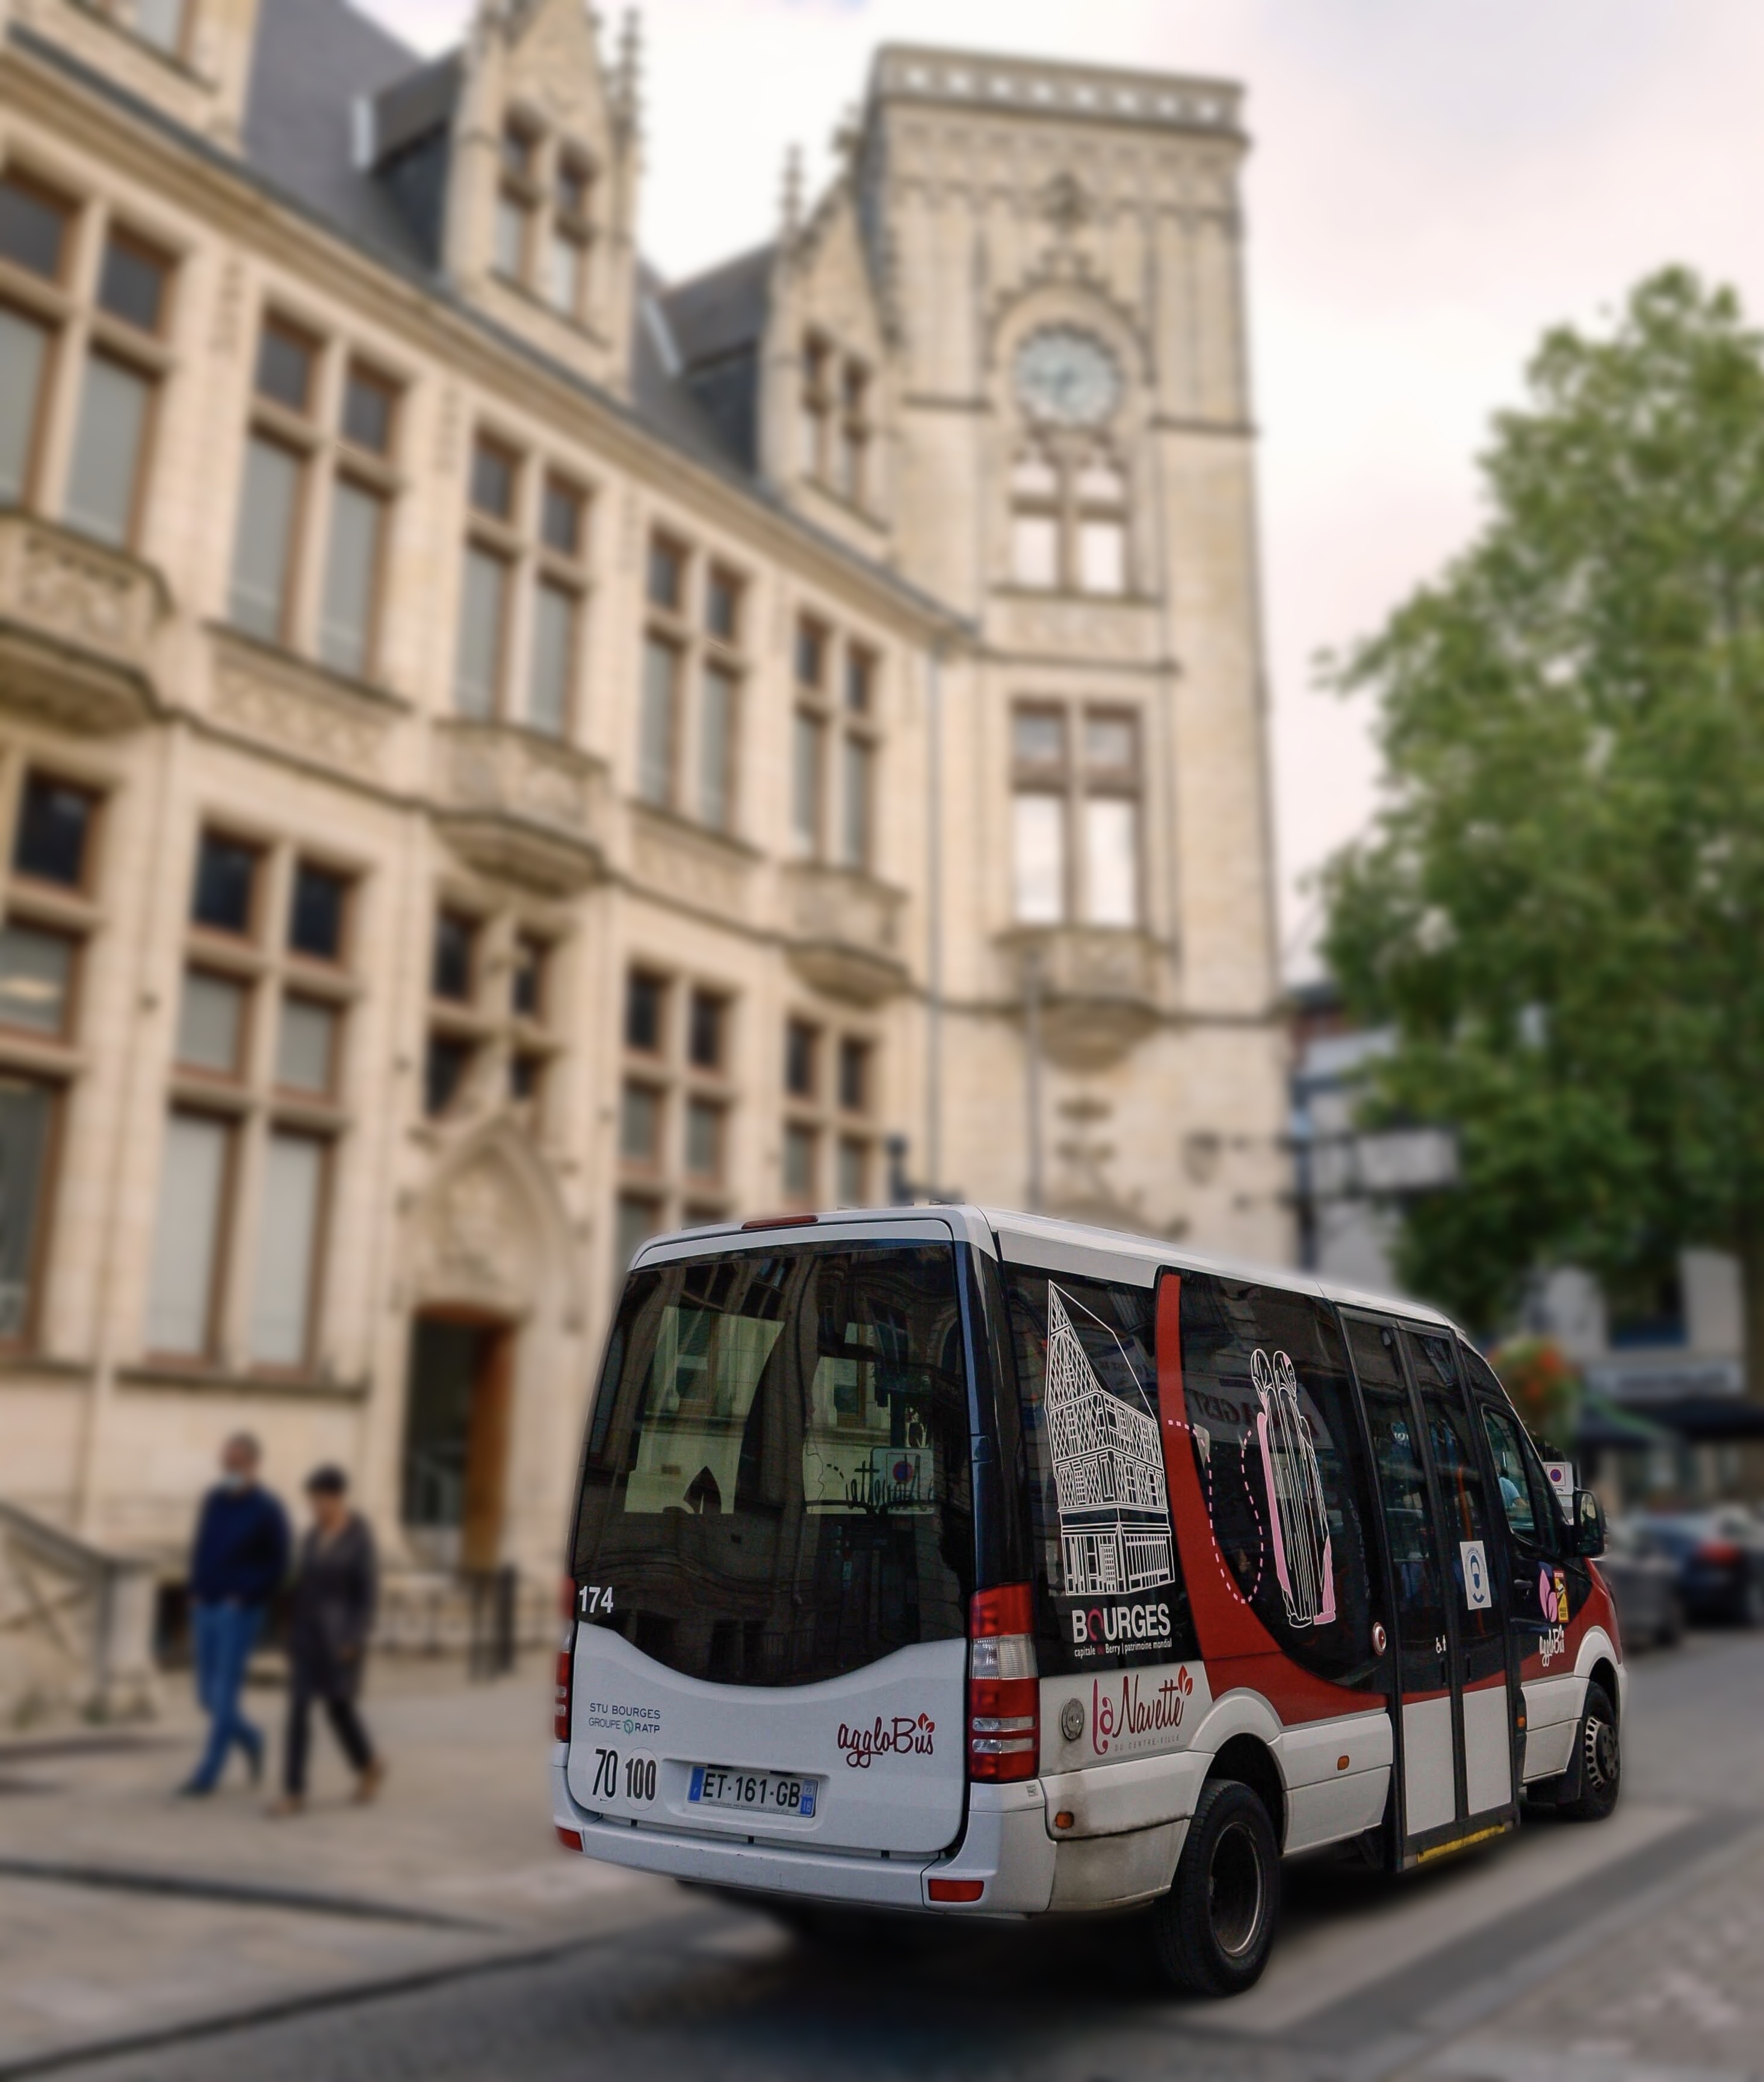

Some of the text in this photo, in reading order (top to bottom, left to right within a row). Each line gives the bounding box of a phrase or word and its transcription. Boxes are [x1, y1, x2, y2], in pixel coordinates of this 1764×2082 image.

[579, 1585, 614, 1614] 174
[1072, 1603, 1171, 1644] BOURGES
[1074, 1645, 1096, 1659] capitale
[1105, 1643, 1121, 1655] Berry
[1125, 1641, 1152, 1655] patrimoine
[1153, 1638, 1172, 1649] mondial
[590, 1703, 661, 1720] STU BOURGES
[1112, 1674, 1184, 1739] Navette
[589, 1717, 660, 1733] GROUPE RATP
[592, 1748, 618, 1798] 70
[625, 1758, 657, 1801] 100
[802, 1800, 812, 1813] 18
